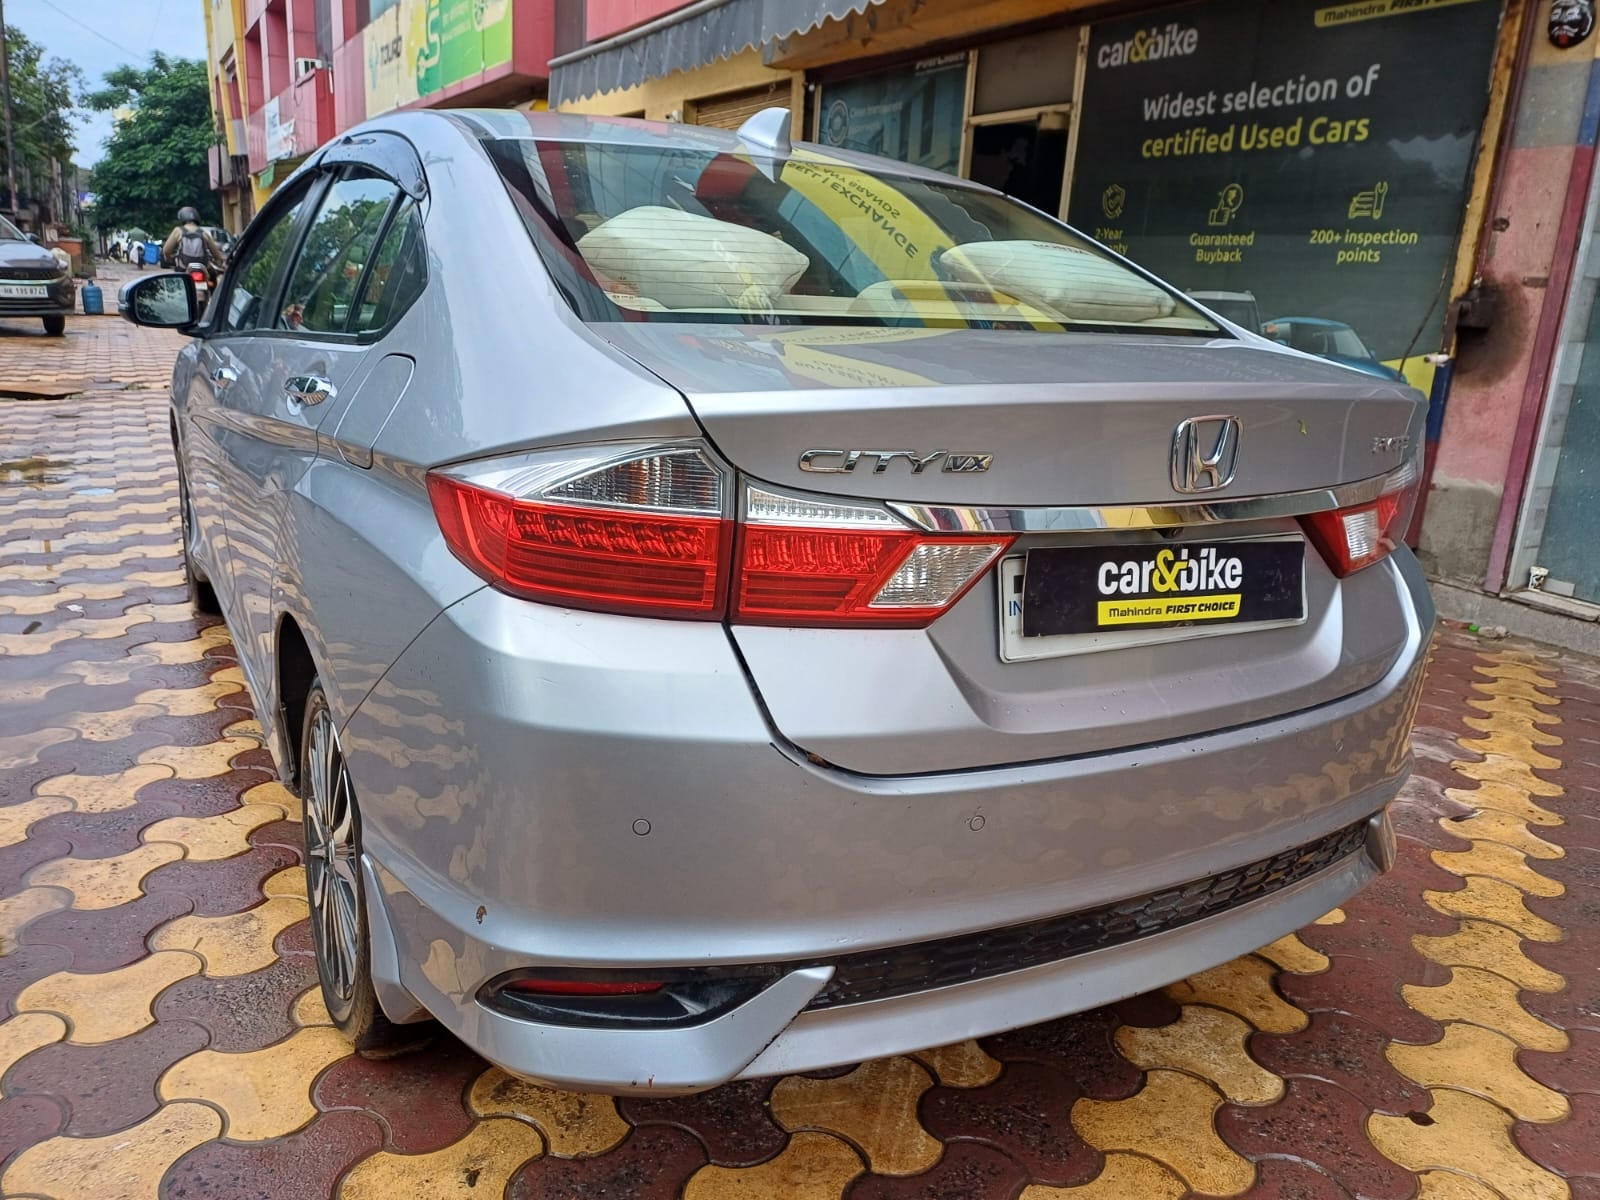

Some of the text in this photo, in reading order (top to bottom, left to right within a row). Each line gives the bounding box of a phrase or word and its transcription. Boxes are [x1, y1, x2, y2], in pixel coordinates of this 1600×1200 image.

[1324, 3, 1386, 22] Mahindra
[1097, 22, 1198, 69] car&bike
[1143, 64, 1380, 121] Widest selection of
[1142, 117, 1370, 158] certified Used Cars
[1094, 228, 1124, 240] 2-Year
[1190, 230, 1255, 246] Guaranteed
[1309, 229, 1418, 246] 200+ inspection
[1196, 248, 1242, 264] Buyback
[1336, 247, 1381, 265] points
[799, 450, 993, 474] CITY VX
[1098, 547, 1243, 595] car&bike
[1109, 601, 1235, 618] Mahindra FIRST CHOICE
